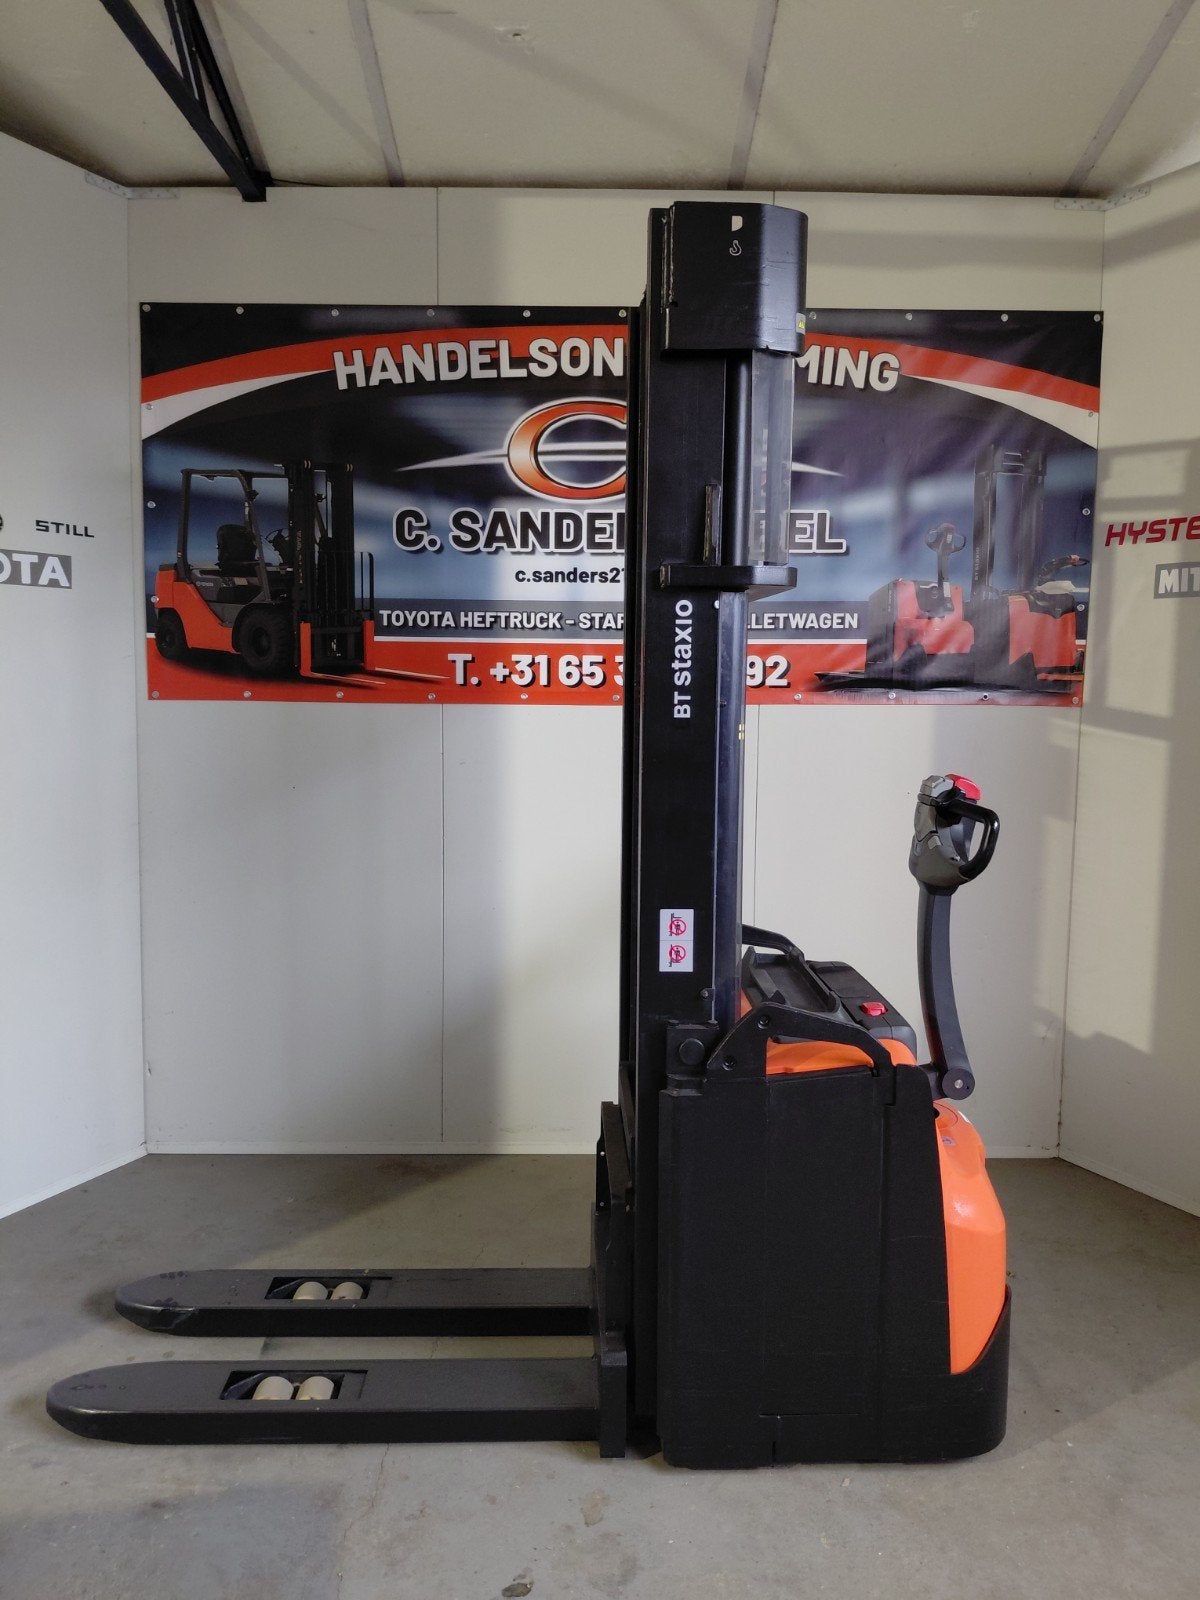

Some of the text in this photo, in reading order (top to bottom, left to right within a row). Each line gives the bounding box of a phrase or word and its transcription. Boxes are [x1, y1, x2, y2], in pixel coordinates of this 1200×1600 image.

[35, 519, 95, 538] STILL
[393, 507, 442, 551] C.
[449, 507, 625, 553] SANDE
[515, 567, 624, 584] c.sanders2
[379, 610, 455, 627] TOYOTA
[460, 611, 561, 629] HEFTRUCK
[747, 612, 858, 629] LETWAGEN
[448, 653, 479, 685] T.
[490, 654, 549, 686] +31
[558, 654, 605, 687] 65
[746, 655, 789, 688] 92
[673, 691, 692, 719] BT
